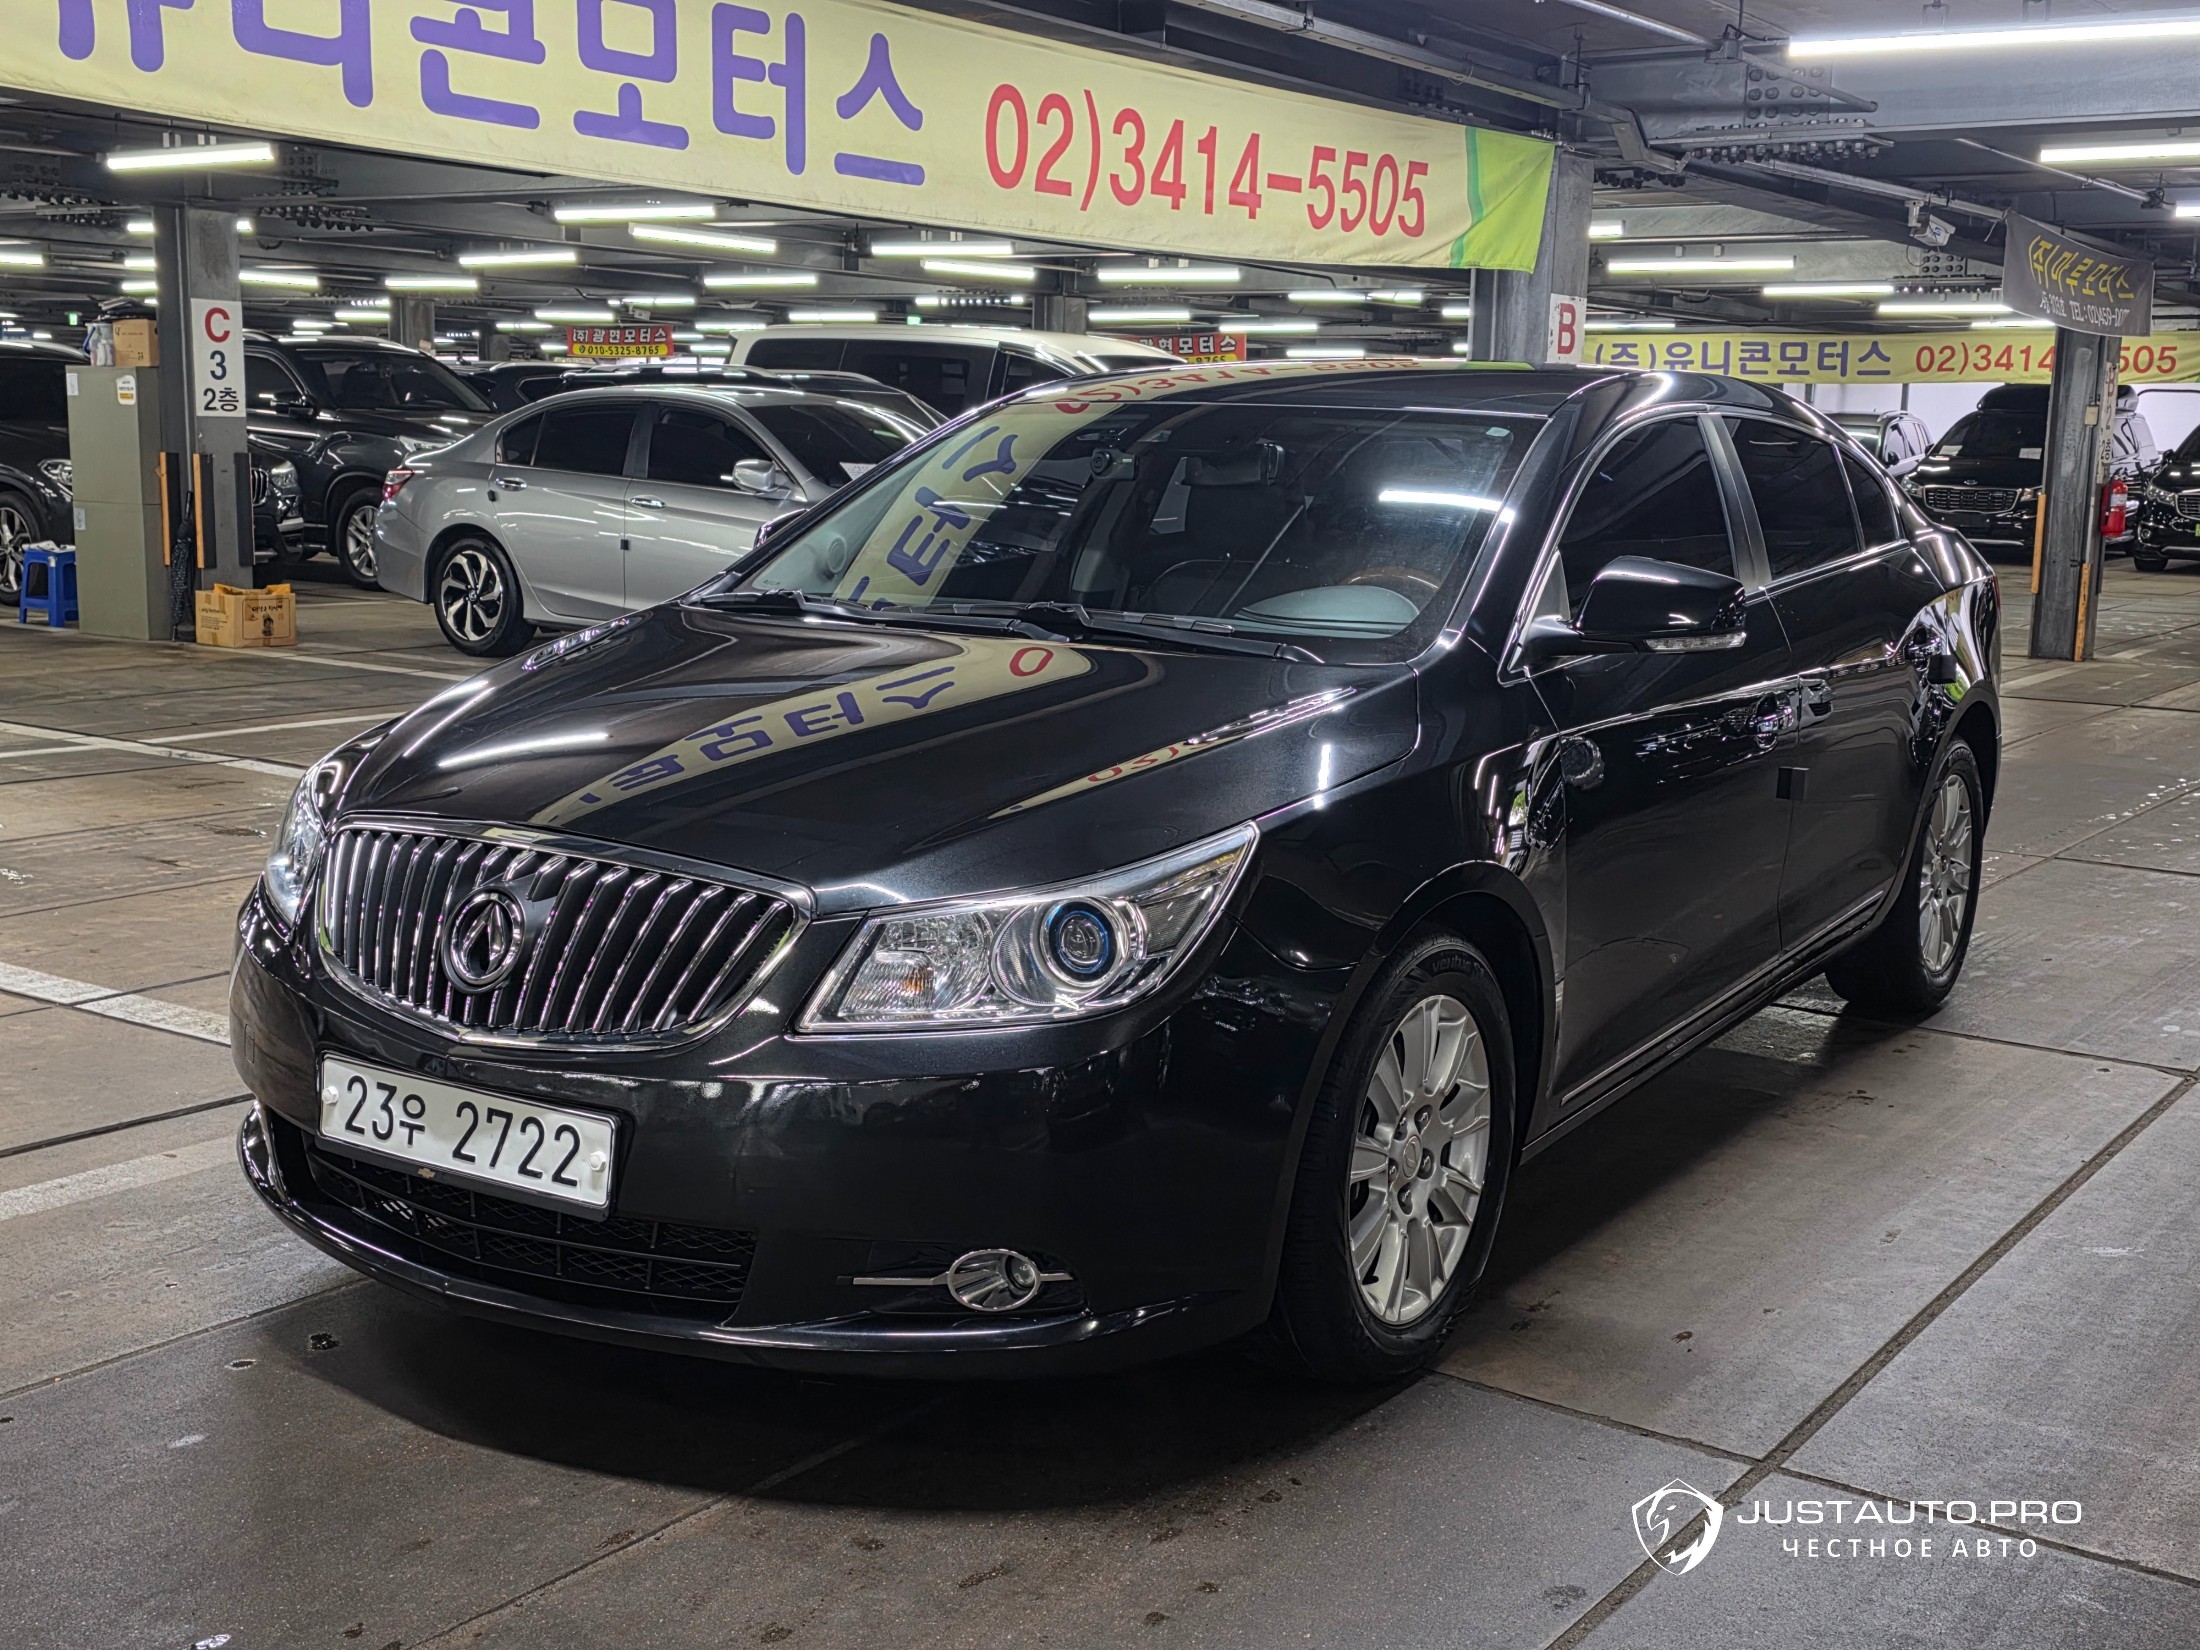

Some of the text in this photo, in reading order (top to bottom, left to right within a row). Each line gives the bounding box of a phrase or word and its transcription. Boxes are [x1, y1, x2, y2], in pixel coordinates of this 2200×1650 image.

[985, 83, 1429, 238] 02)3414-5505
[204, 307, 231, 343] C
[1557, 303, 1576, 355] B
[209, 350, 227, 380] 3
[1595, 340, 1892, 377] (주)유니콘모터스
[203, 387, 239, 412] 2층
[345, 1075, 581, 1187] 23우 2722
